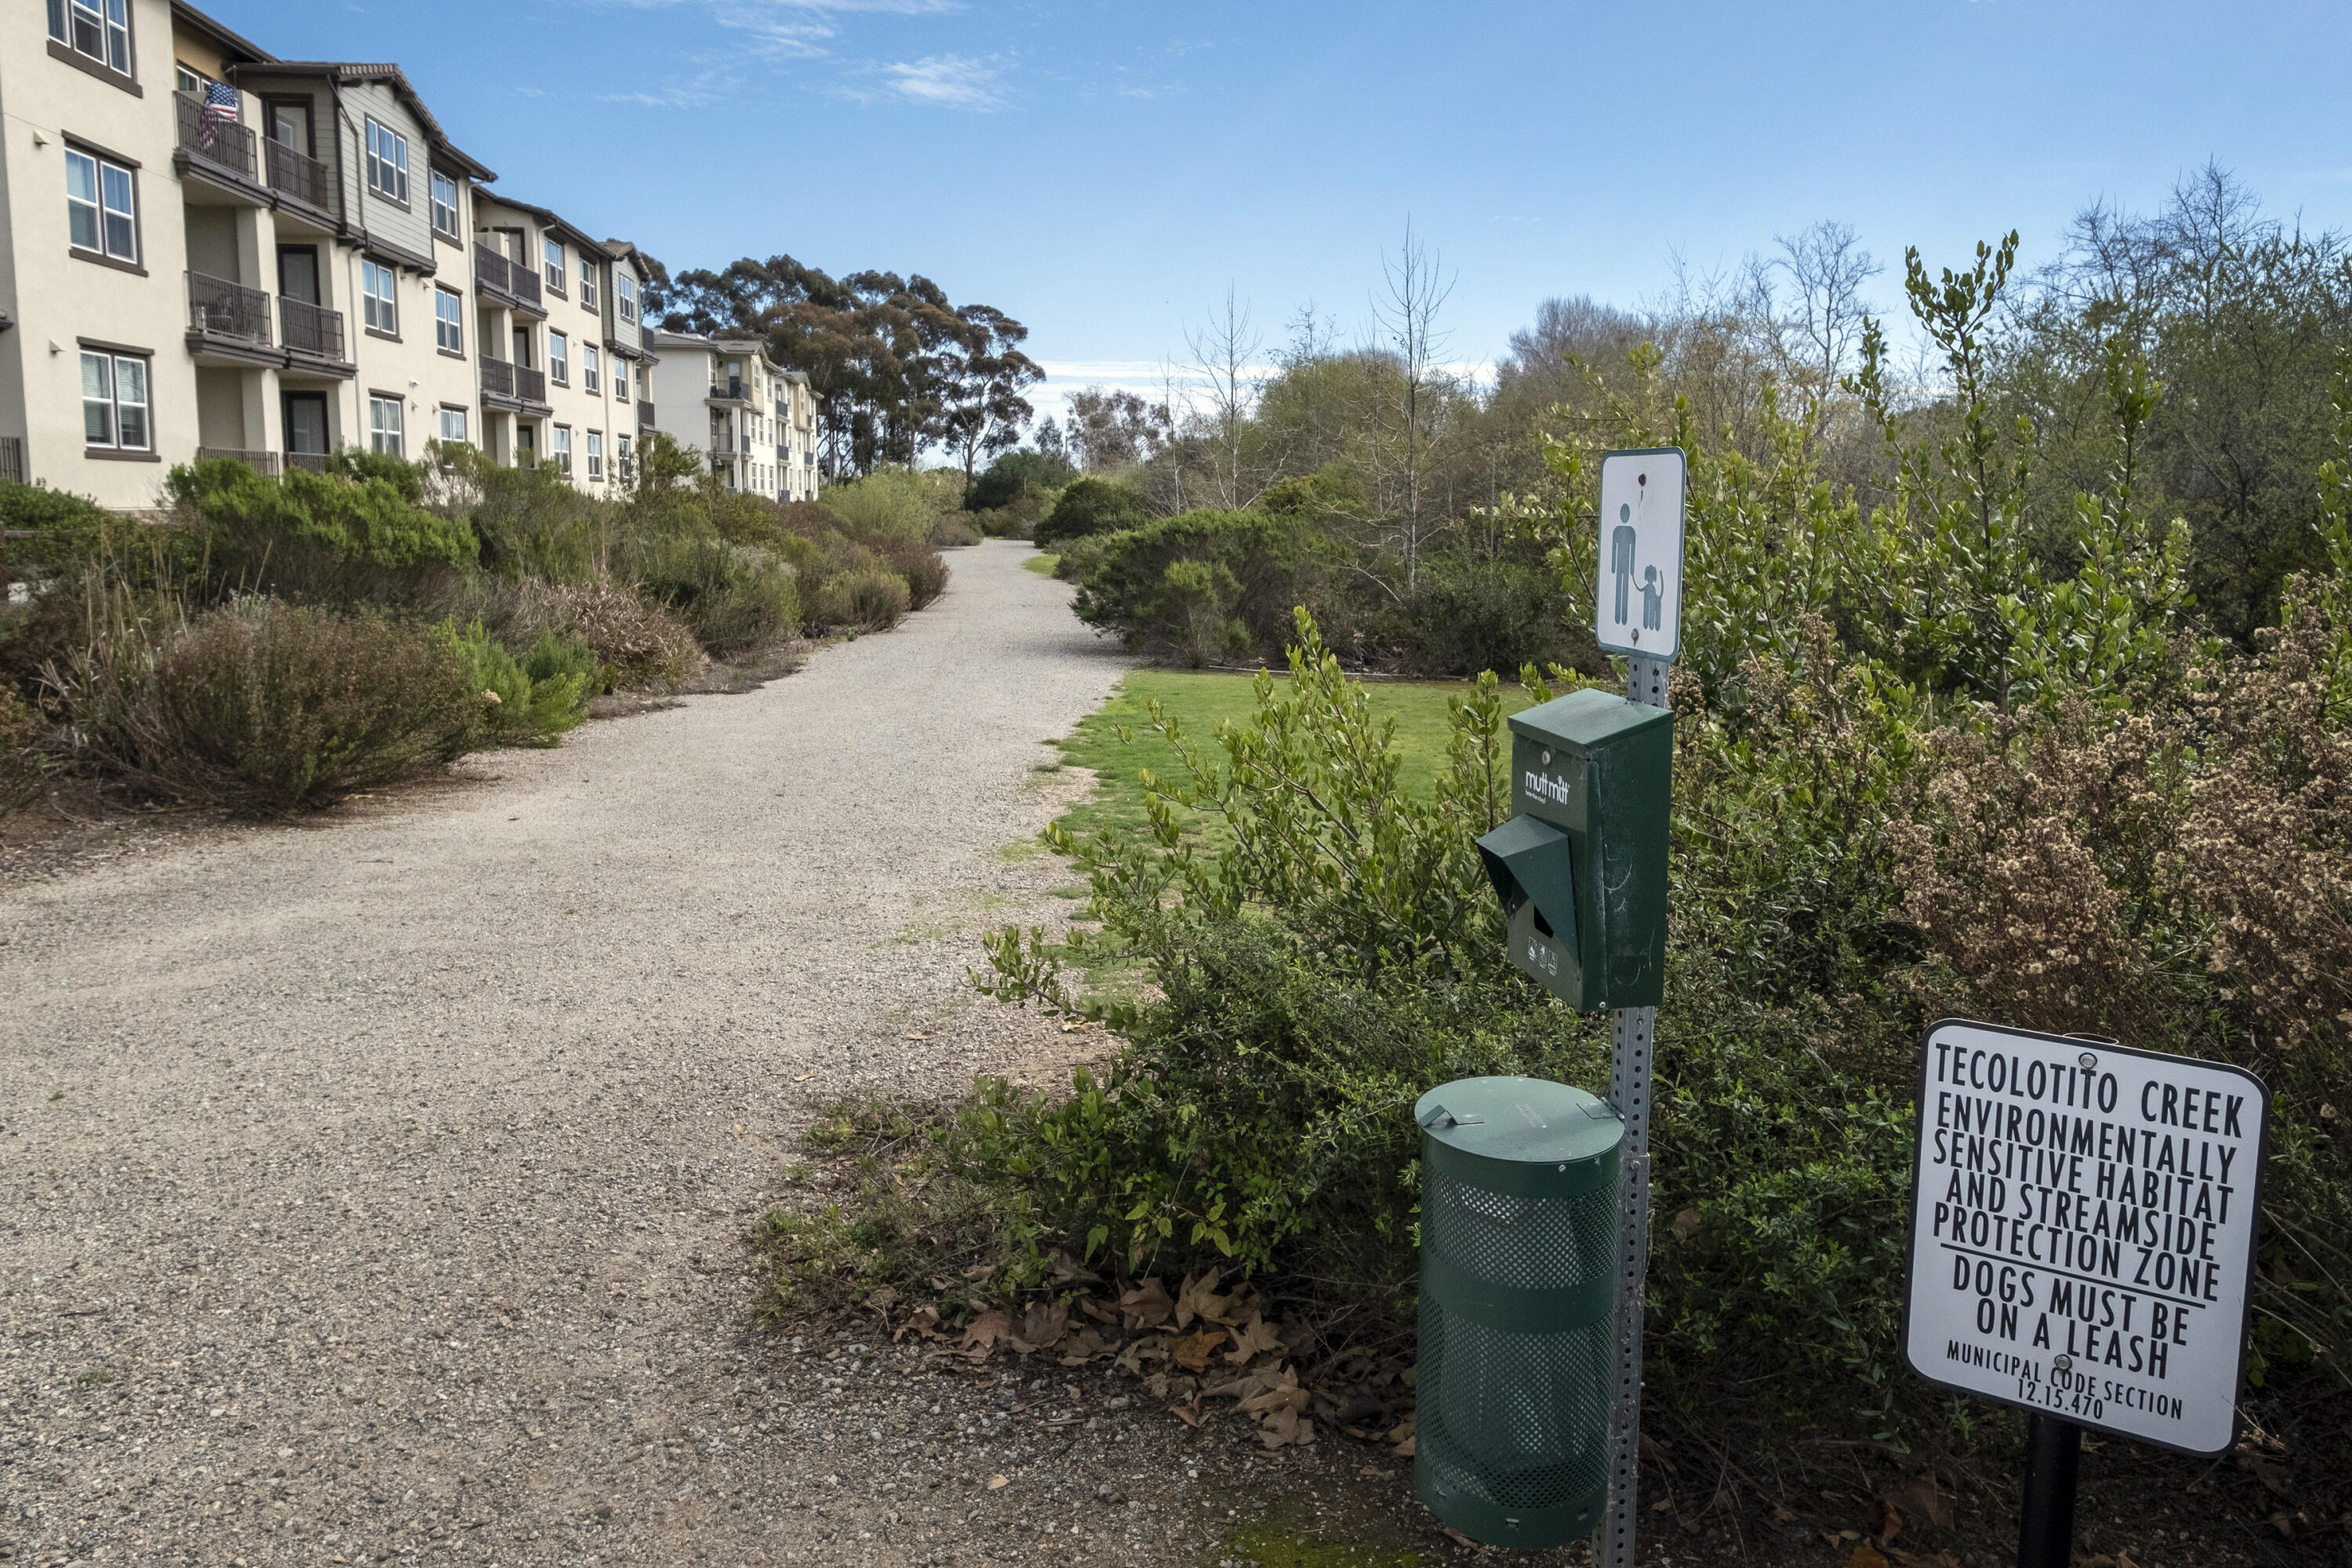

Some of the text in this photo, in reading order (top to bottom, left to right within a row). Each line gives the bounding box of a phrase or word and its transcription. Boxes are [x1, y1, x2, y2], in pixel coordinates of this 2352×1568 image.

[1935, 1042, 2245, 1139] TECOLOTITO CREEK
[1933, 1127, 2234, 1225] SENSITIVE HABITAT
[1937, 1091, 2237, 1185] ENVIRONMENTALLY
[1933, 1201, 2221, 1302] PROTECTION ZONE
[1945, 1168, 2217, 1261] AND STREAMSIDE
[1953, 1254, 2190, 1347] DOGS MUST BE
[1976, 1298, 2169, 1381] ON A LEASH
[1946, 1339, 2183, 1421] MUNICIPAL CODE SECTION
[2018, 1377, 2103, 1420] 12.15.470
